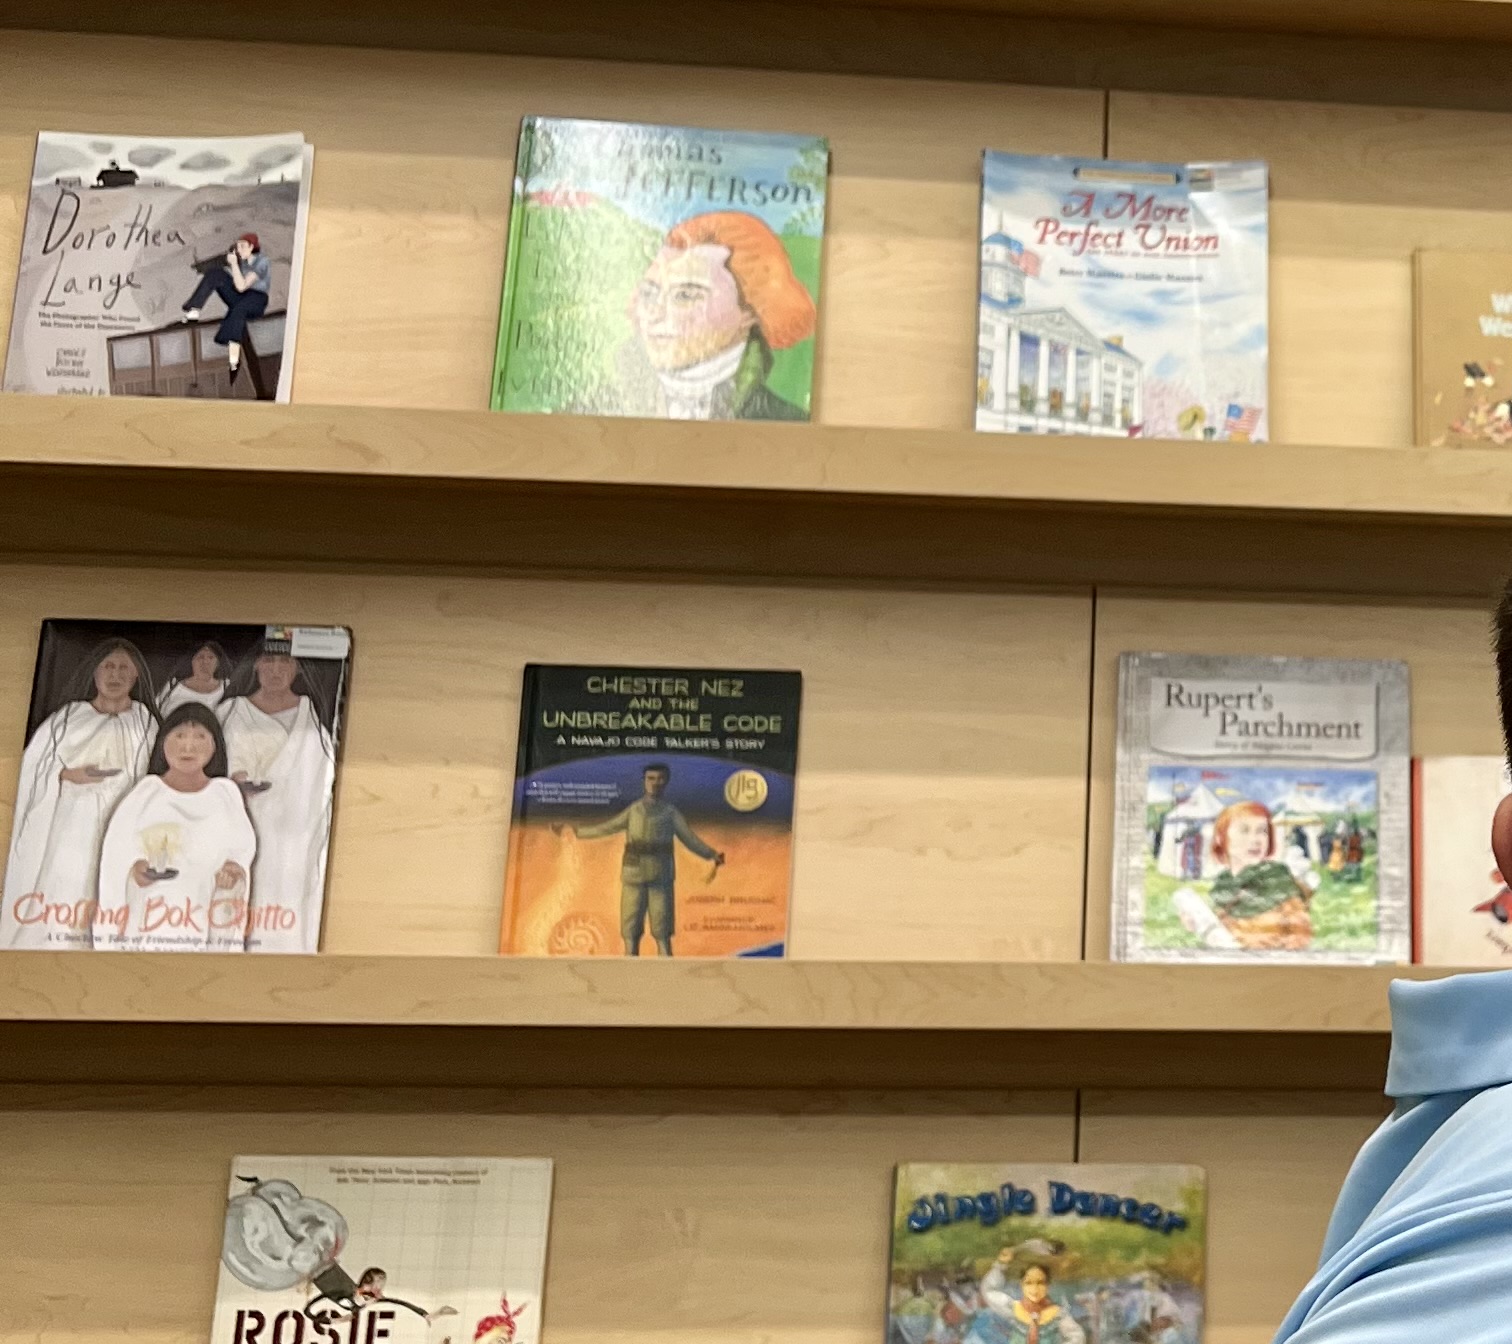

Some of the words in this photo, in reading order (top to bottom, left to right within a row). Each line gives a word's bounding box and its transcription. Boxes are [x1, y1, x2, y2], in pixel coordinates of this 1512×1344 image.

[42, 187, 186, 256] Dorothea
[1060, 189, 1097, 219] A
[1104, 191, 1190, 223] More
[1034, 216, 1126, 256] Perfect
[1133, 223, 1220, 253] Union
[40, 249, 142, 311] Lange
[586, 675, 690, 697] CHESTER
[701, 678, 746, 698] NEZ
[1164, 681, 1275, 719] Rupert's
[628, 697, 663, 711] AND
[669, 698, 700, 712] THE
[541, 709, 714, 733] UNBREAKABLE
[722, 714, 784, 735] CODE
[1217, 711, 1364, 740] Parchment
[555, 735, 567, 746] A
[13, 892, 130, 935] Crossing
[139, 896, 202, 933] Bok
[208, 898, 296, 933] Chitto
